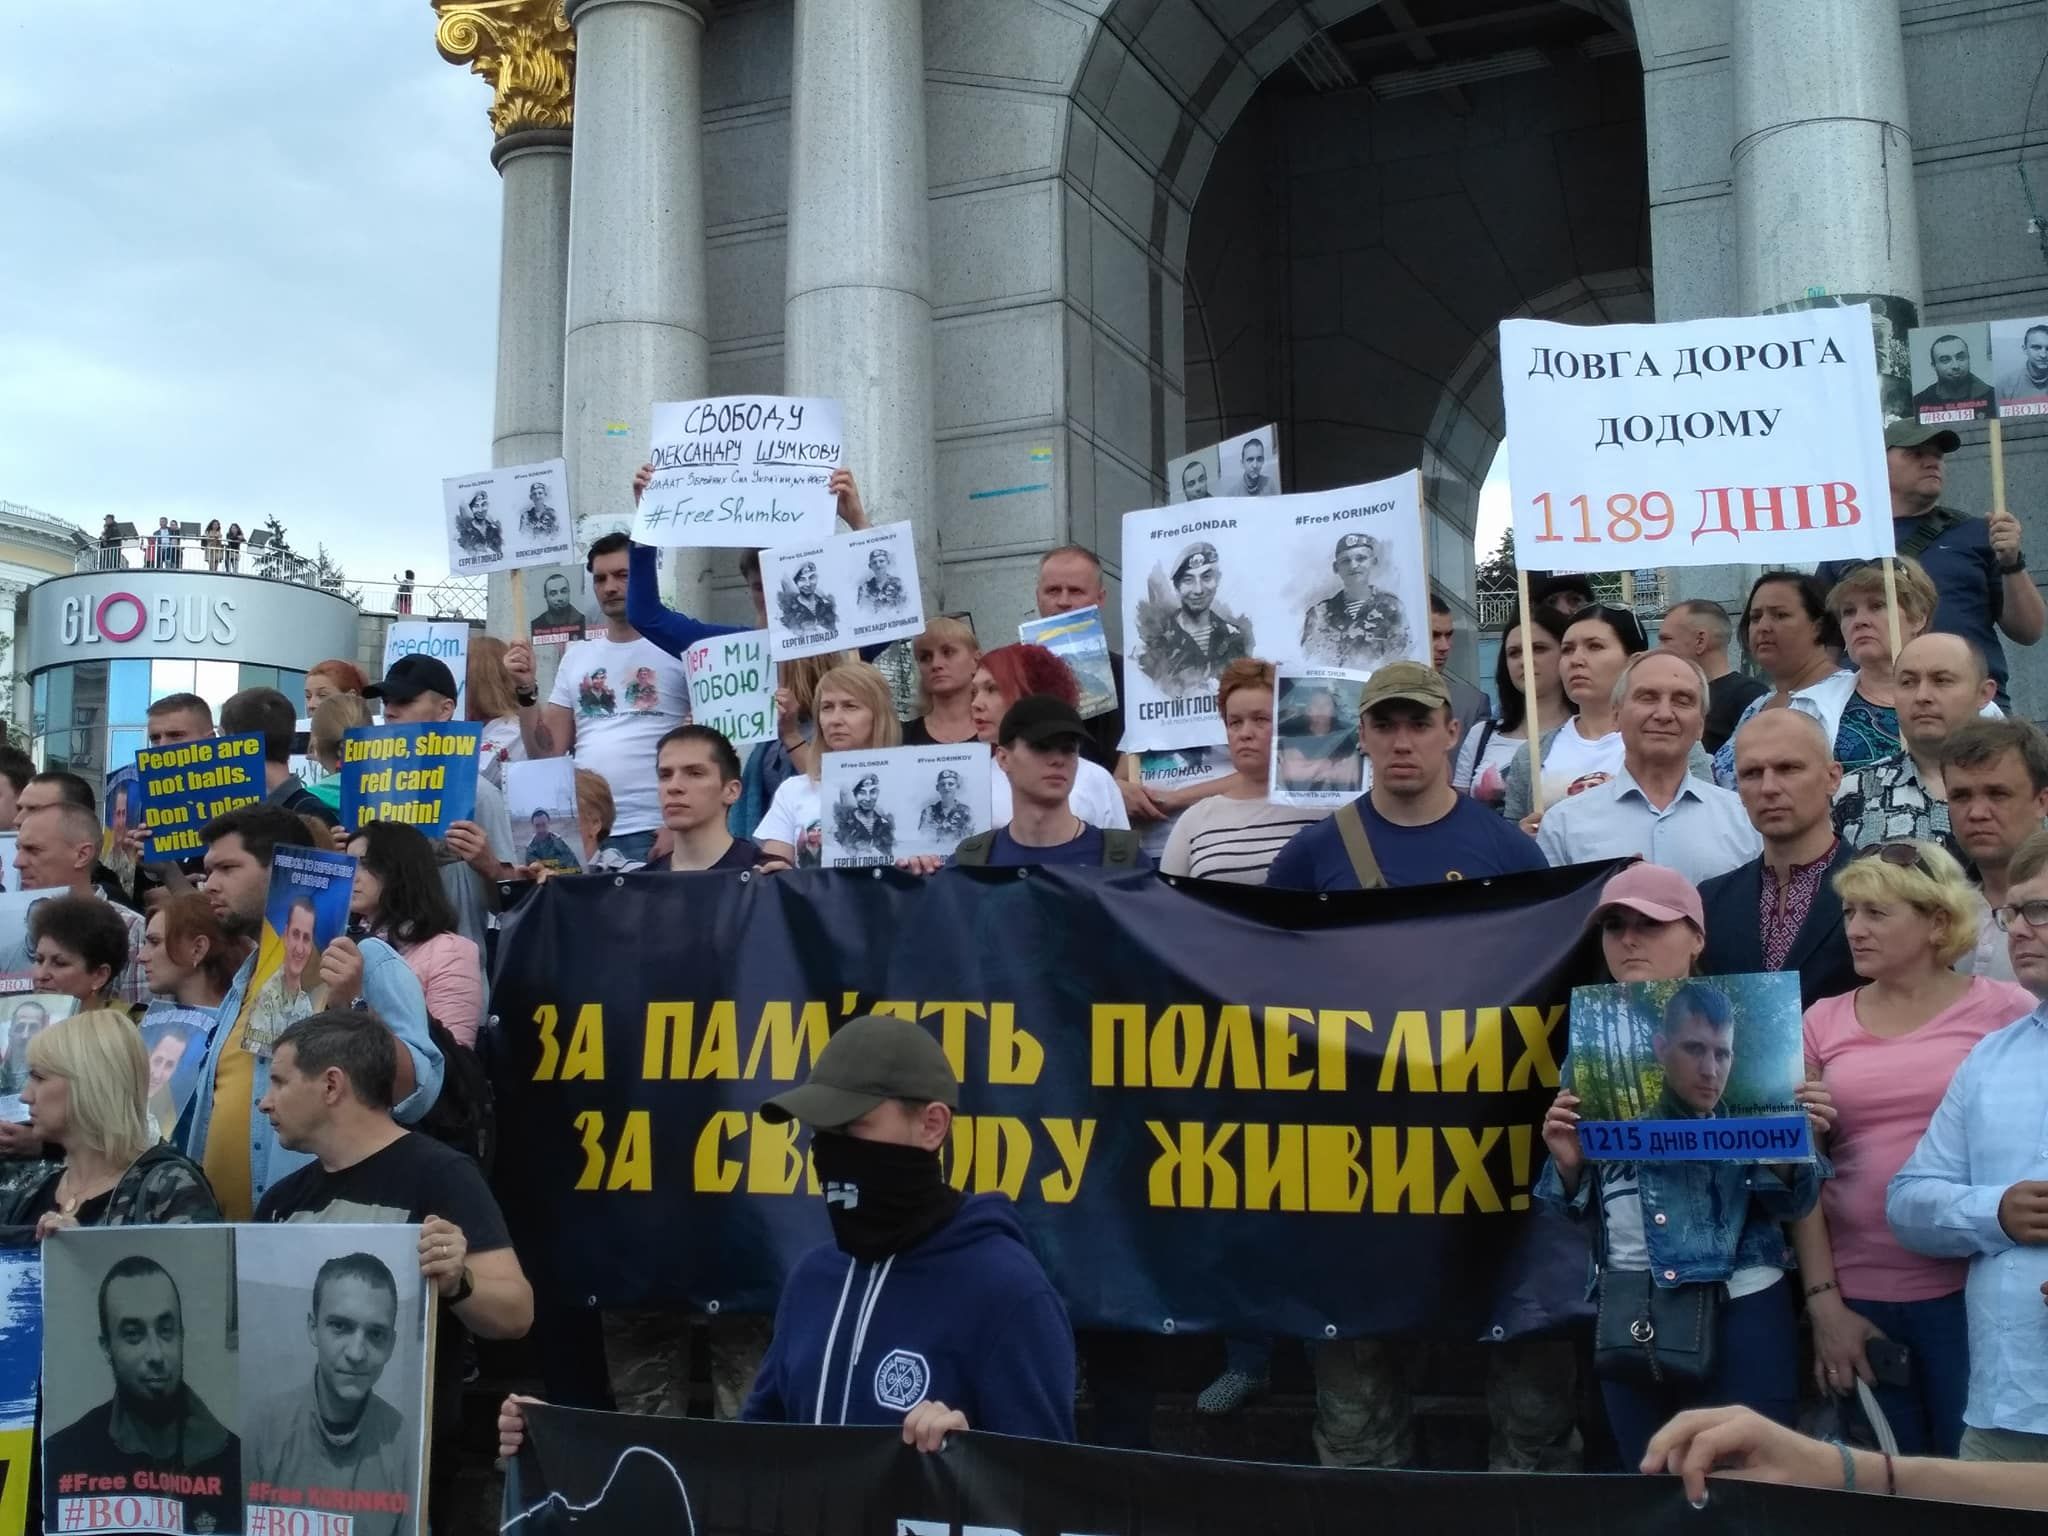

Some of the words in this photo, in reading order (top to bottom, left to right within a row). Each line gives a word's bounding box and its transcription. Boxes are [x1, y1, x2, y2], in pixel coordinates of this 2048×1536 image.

[1528, 346, 1662, 382] ДОВГА
[1673, 336, 1846, 383] ДОРОГА
[684, 403, 804, 436] СВОБОДУ
[1595, 408, 1782, 451] ДОДОМУ
[651, 439, 743, 467] ОЛЕКСАНДРУ
[756, 440, 840, 463] ШУМКОВУ
[1295, 513, 1330, 525] #Free
[1332, 501, 1396, 521] KORINKOV
[1532, 491, 1675, 543] 1189
[1691, 481, 1862, 546] ДНІВ
[1150, 527, 1179, 539] #Free
[1181, 519, 1238, 535] GLONDAR
[60, 592, 237, 645] GLOBUS
[1139, 697, 1184, 720] СЕРГІЙ
[138, 744, 213, 772] People
[218, 738, 260, 758] are
[344, 735, 410, 763] Europe,
[415, 732, 477, 757] show
[148, 774, 185, 796] not
[188, 766, 251, 791] balls.
[360, 768, 392, 794] red
[395, 766, 446, 792] card
[1157, 765, 1213, 779] ГЛОНДАР
[357, 806, 376, 827] to
[380, 800, 442, 824] Putin!
[153, 829, 203, 852] with
[532, 1003, 604, 1080] ЗА
[642, 992, 1045, 1085] ПАМ'ТЬ
[1091, 1003, 1567, 1092] ПОЛЕГЛИХ
[1581, 1126, 1642, 1151] 1215
[1650, 1132, 1698, 1155] ДНІВ
[1704, 1128, 1801, 1151] ПОЛОНУ
[572, 1110, 652, 1190] ЗА
[1145, 1119, 1532, 1214] ЖИВИХ!
[58, 1472, 126, 1493] #Free
[133, 1470, 222, 1496] GLONDAR
[248, 1481, 304, 1500] #Free
[64, 1497, 183, 1530] #ВОЛЯ
